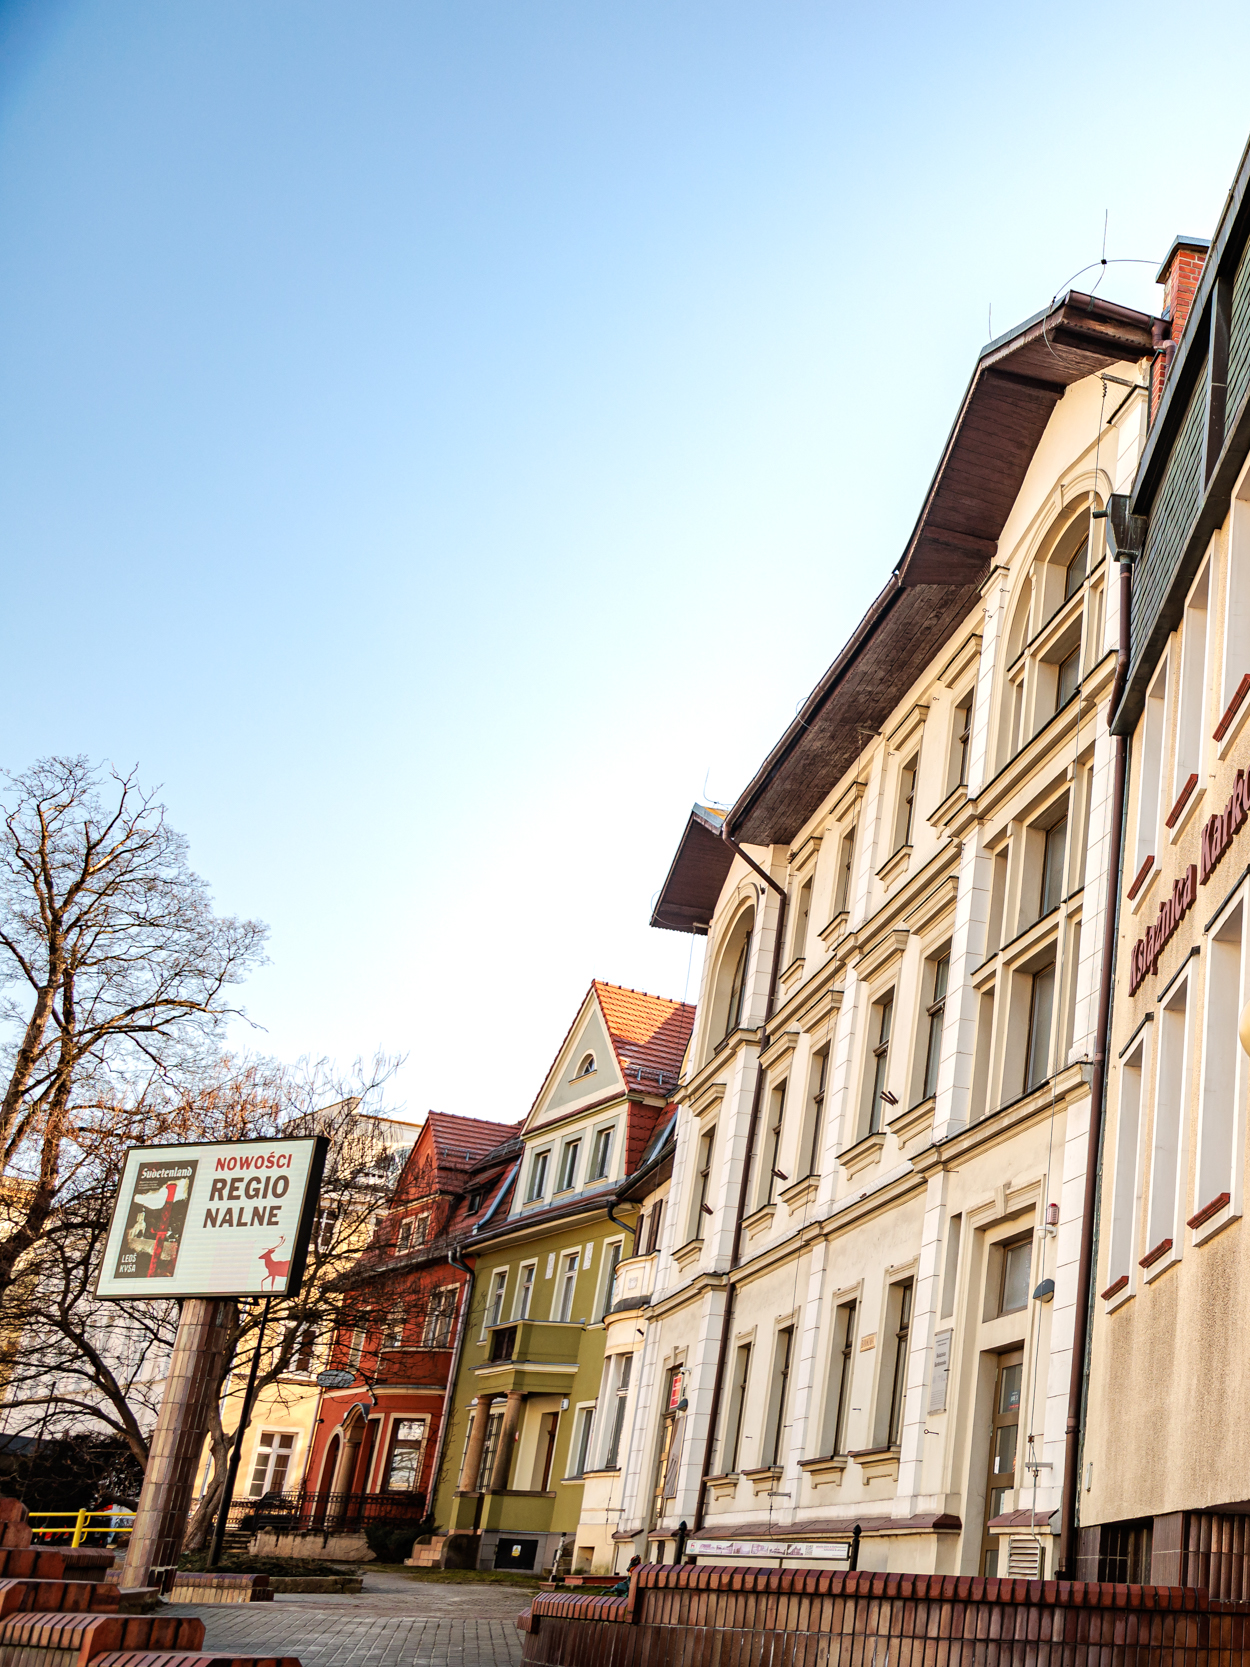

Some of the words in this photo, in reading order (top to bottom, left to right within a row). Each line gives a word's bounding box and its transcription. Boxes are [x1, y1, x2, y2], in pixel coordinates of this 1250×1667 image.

[1128, 864, 1197, 997] Książnica
[141, 1166, 193, 1179] Sudetenland
[215, 1151, 293, 1172] NOWOŚCI
[209, 1175, 290, 1201] REGIO
[203, 1206, 282, 1228] NALNE
